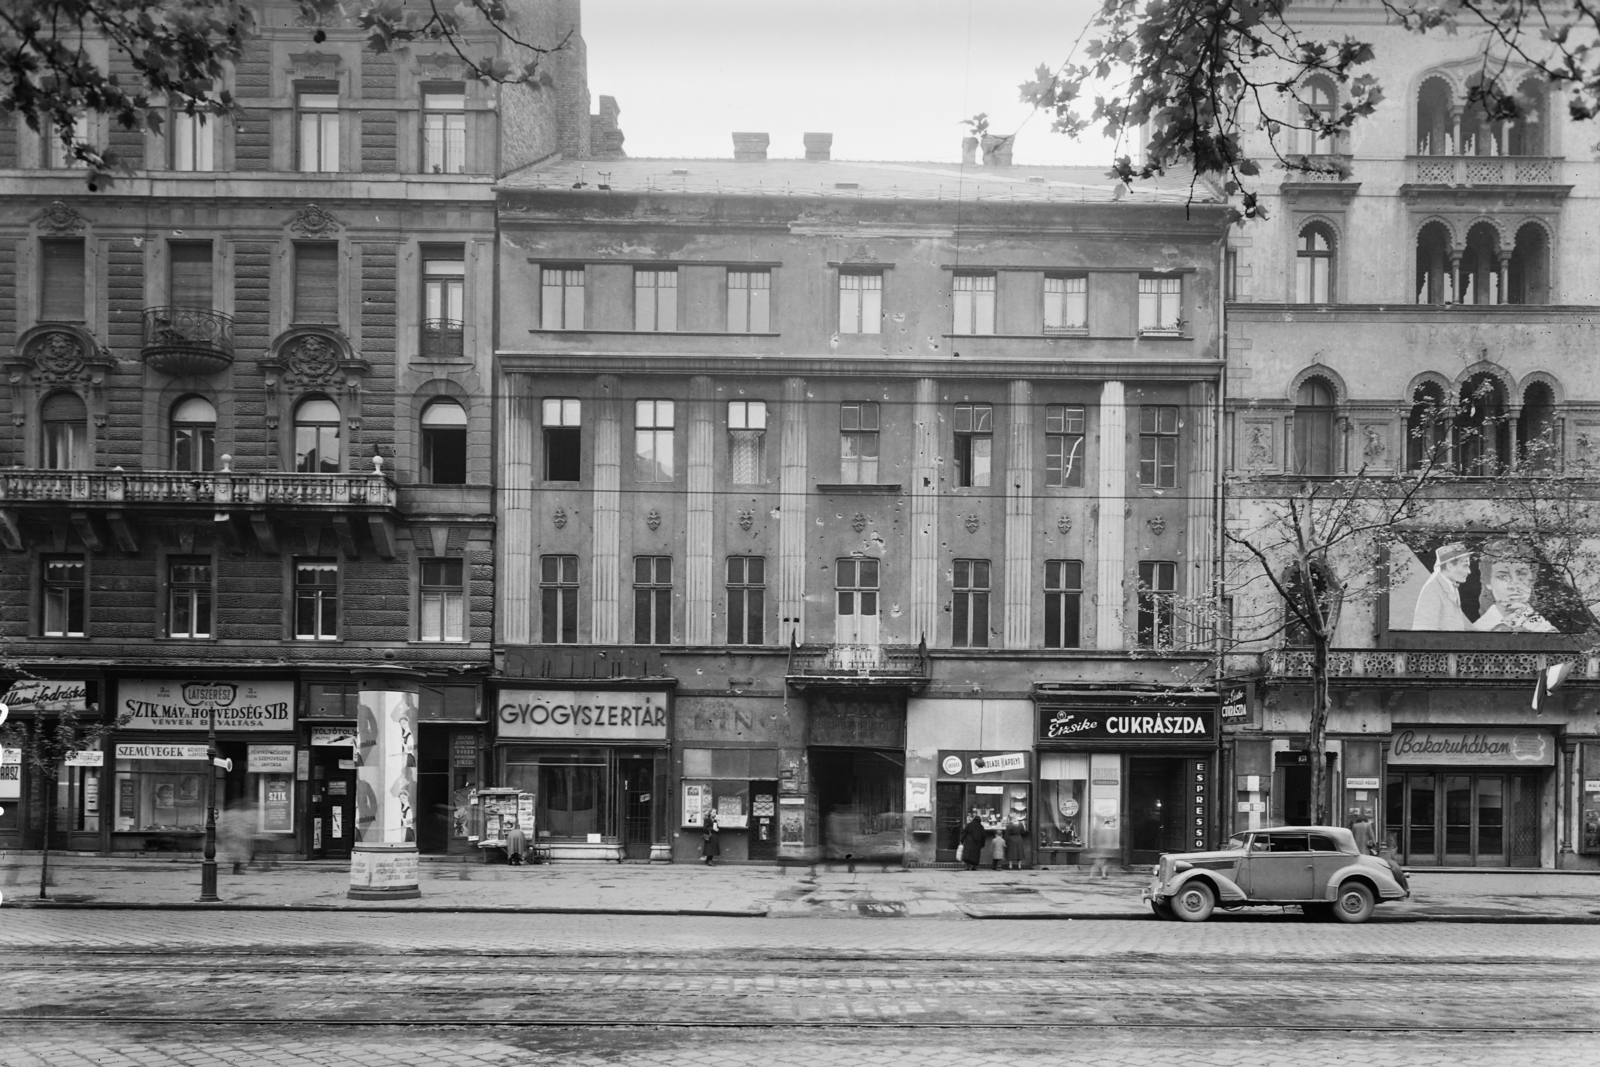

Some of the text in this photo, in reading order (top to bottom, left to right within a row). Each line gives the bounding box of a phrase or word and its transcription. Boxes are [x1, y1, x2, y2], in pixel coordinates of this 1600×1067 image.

[188, 687, 231, 700] LÁTSZERÉSZ
[191, 704, 263, 719] HOVÉDSÉG
[1221, 702, 1247, 718] CUKRÁSZDA
[152, 718, 264, 726] VÉNYEK BVÁLTÁSA
[1048, 713, 1206, 738] Erzsike CUKRÁSZDA
[1394, 730, 1512, 756] Bakaruhában
[269, 792, 287, 801] SZTK
[1195, 763, 1204, 848] ESPRESSO
